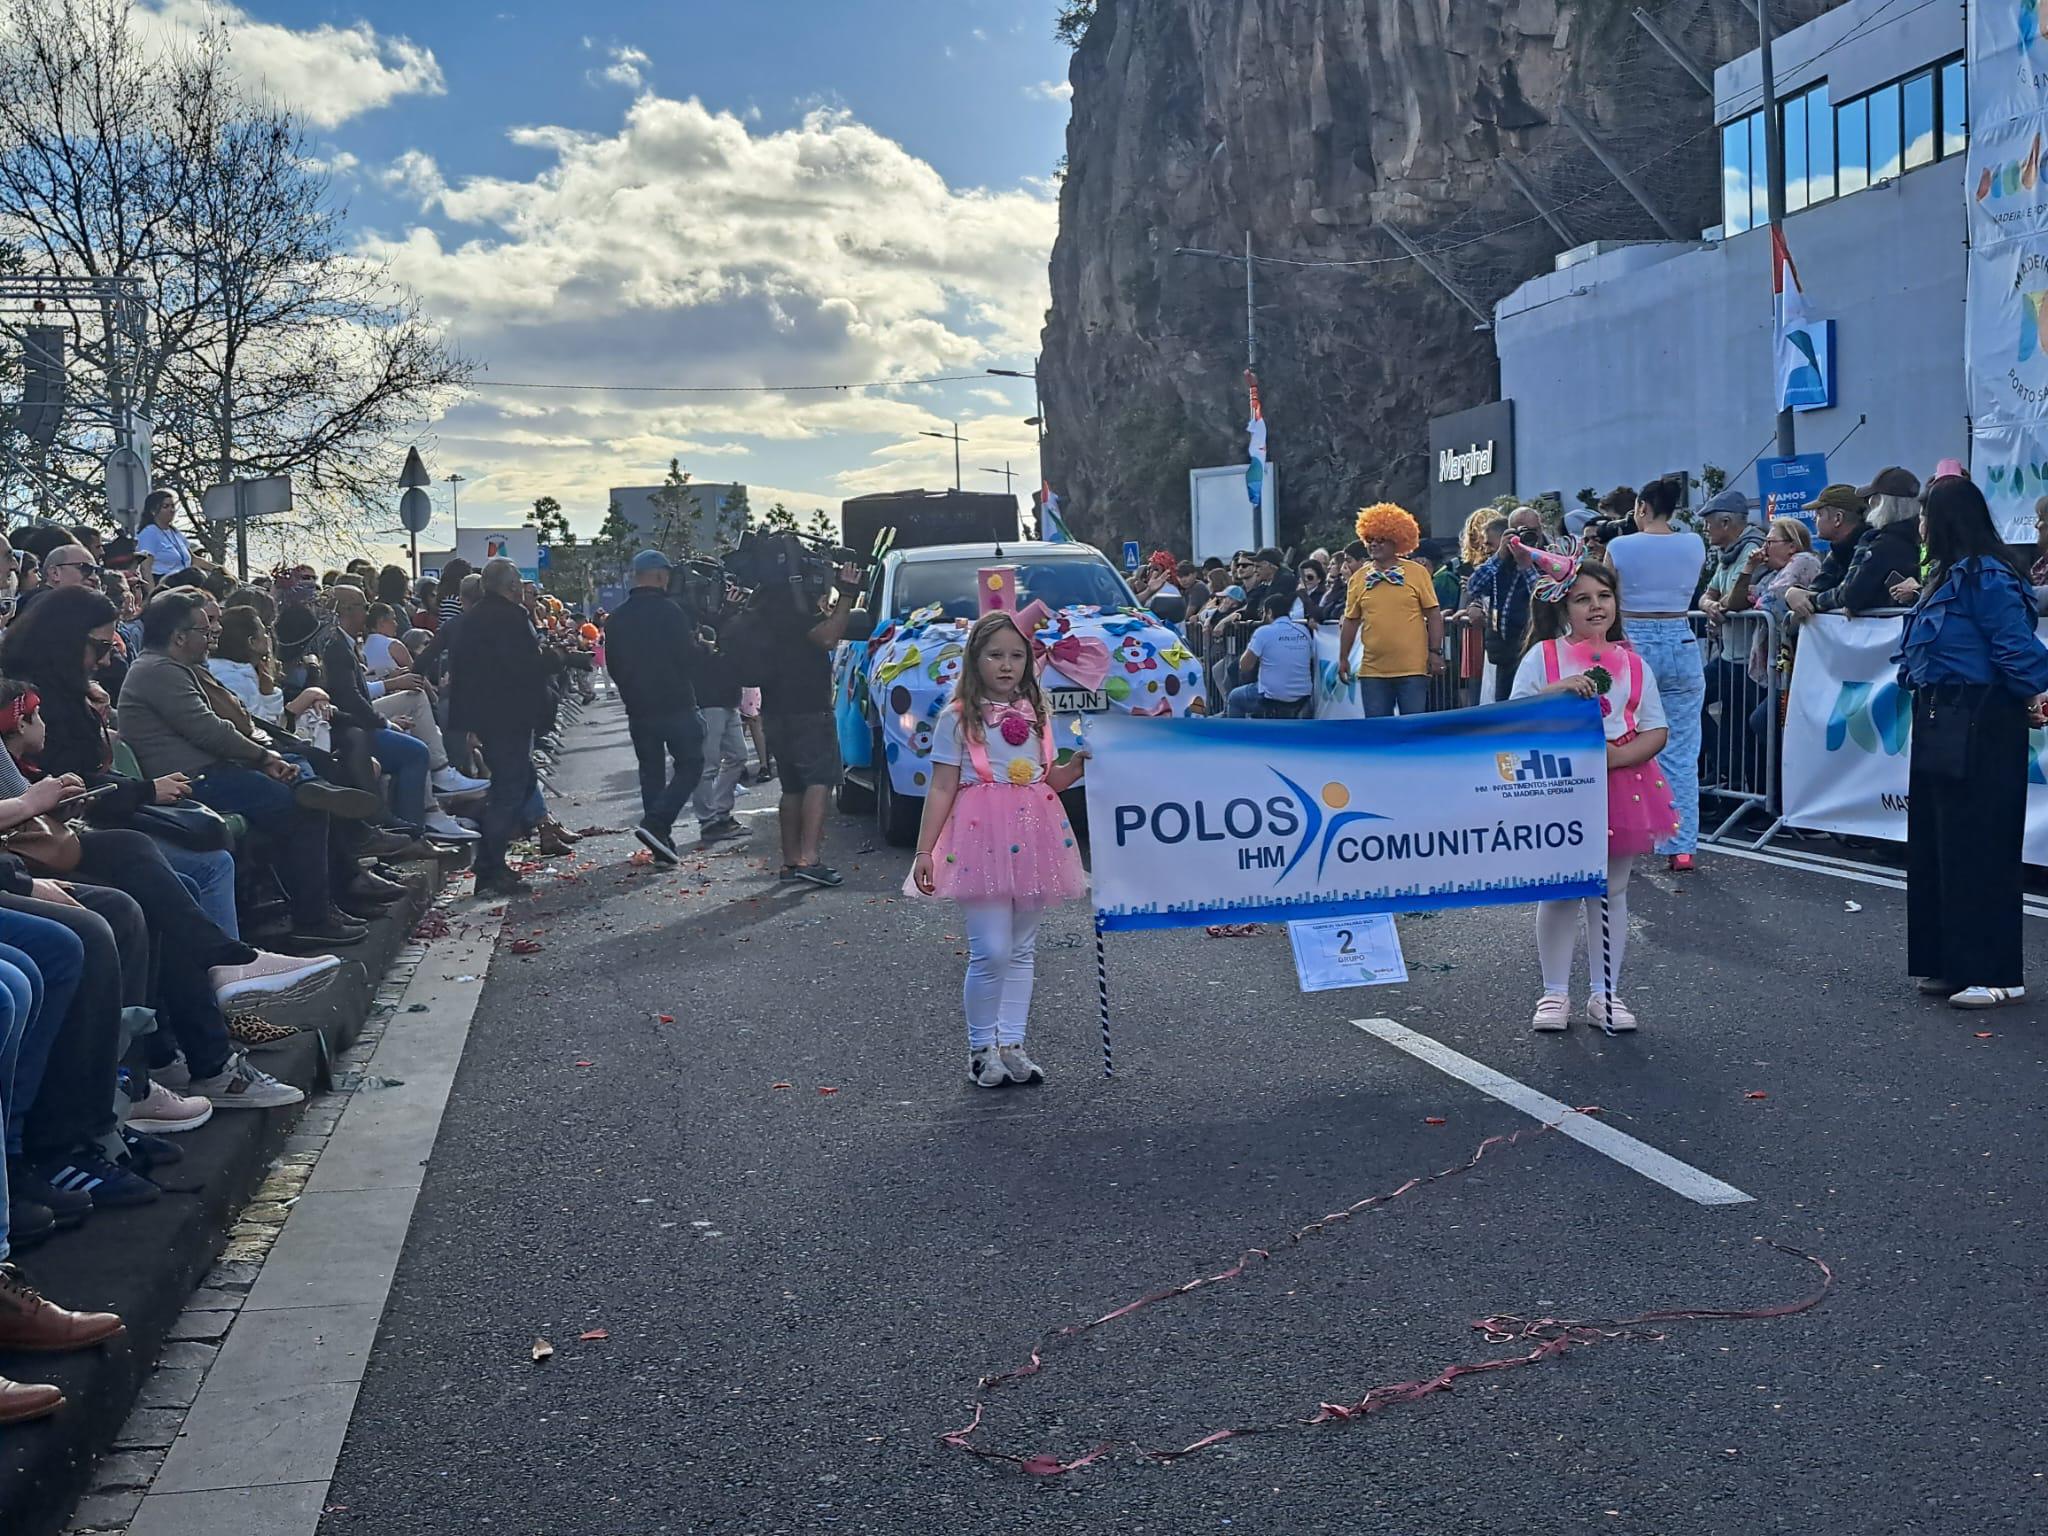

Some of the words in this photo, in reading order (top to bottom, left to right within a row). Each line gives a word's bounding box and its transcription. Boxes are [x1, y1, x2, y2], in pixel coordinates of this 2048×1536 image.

[2008, 368, 2035, 403] PORTO
[1439, 439, 1493, 486] Marginal
[1768, 491, 1806, 501] VAMOS
[1768, 502, 1798, 512] FAZER
[1493, 780, 1547, 791] INVESTIMENTOS
[1548, 777, 1595, 787] HABITACIONAIS
[1547, 786, 1574, 795] EPERAM
[1115, 796, 1299, 847] POLOS
[1238, 845, 1286, 870] IHM
[1337, 820, 1584, 864] COMUNITÁRIOS
[1336, 929, 1356, 954] 2
[1337, 954, 1366, 964] GRUPO
